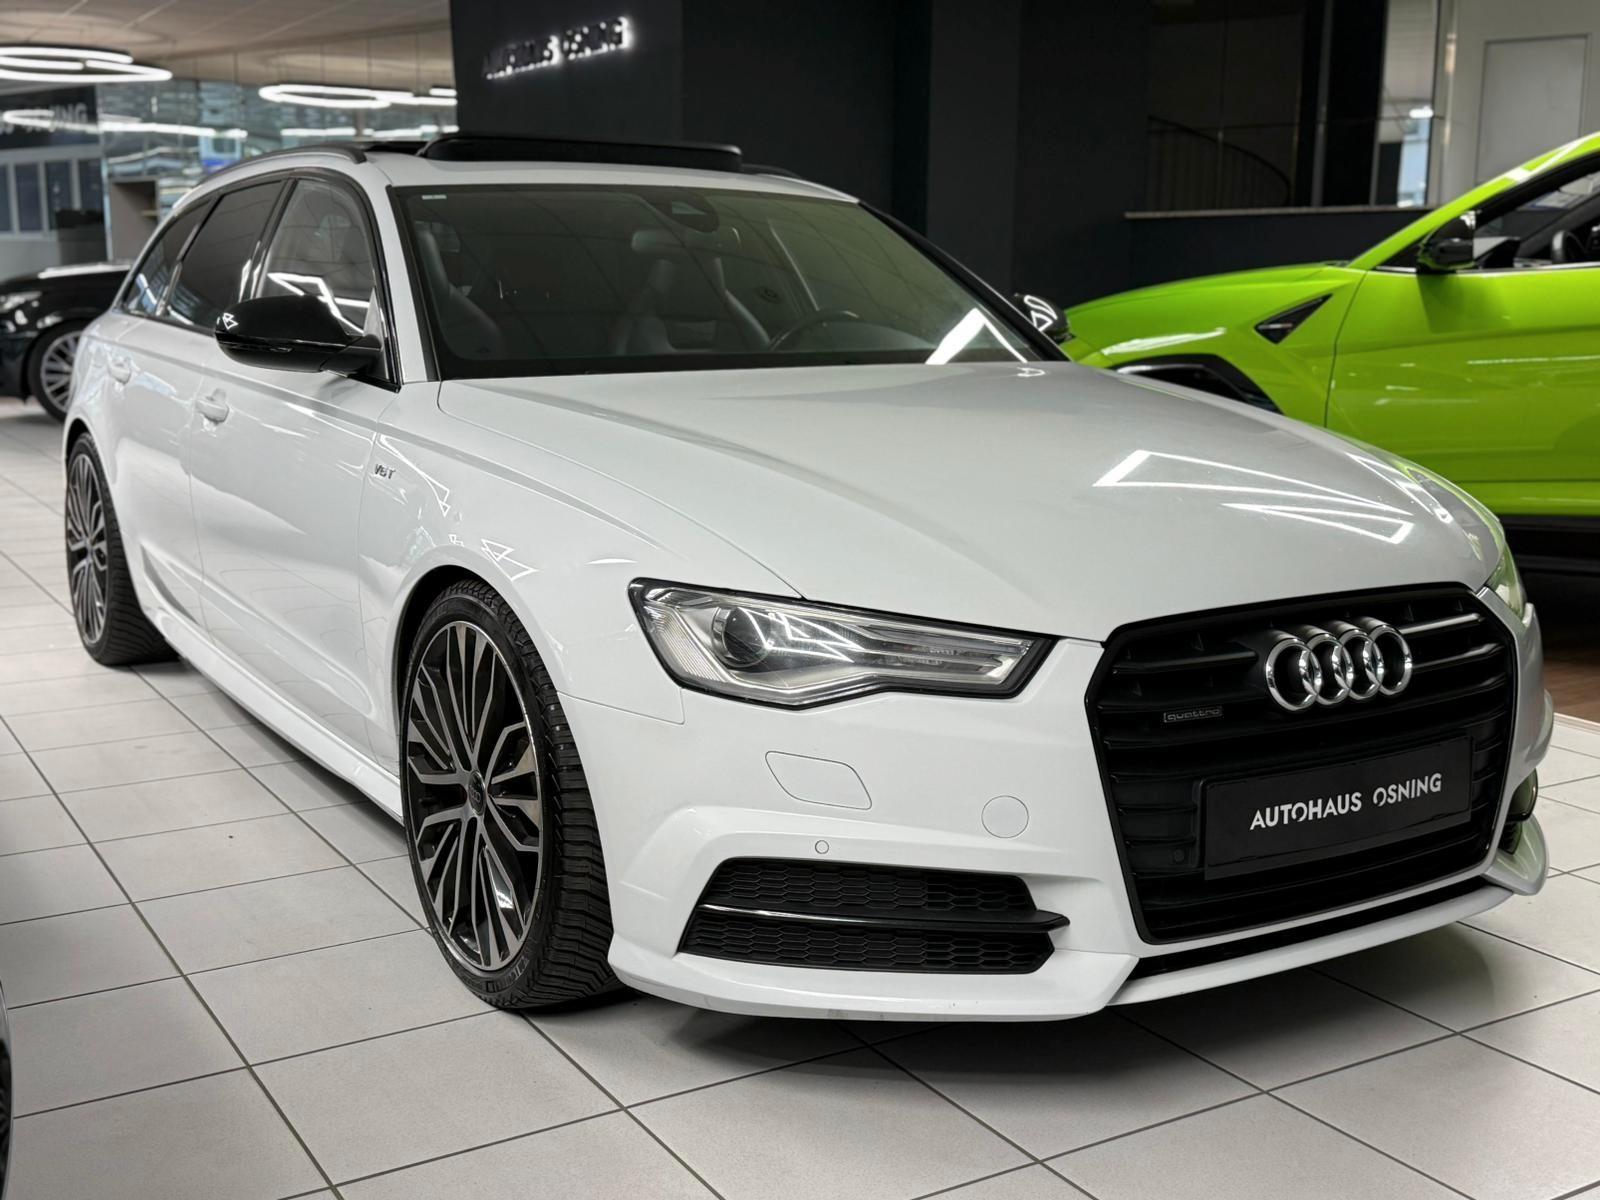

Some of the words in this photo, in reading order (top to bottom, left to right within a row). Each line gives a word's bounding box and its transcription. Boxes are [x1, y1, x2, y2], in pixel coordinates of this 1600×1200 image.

[1165, 707, 1221, 721] quattro
[1250, 791, 1362, 830] AUTOHAUS
[1373, 772, 1442, 807] OSNING
